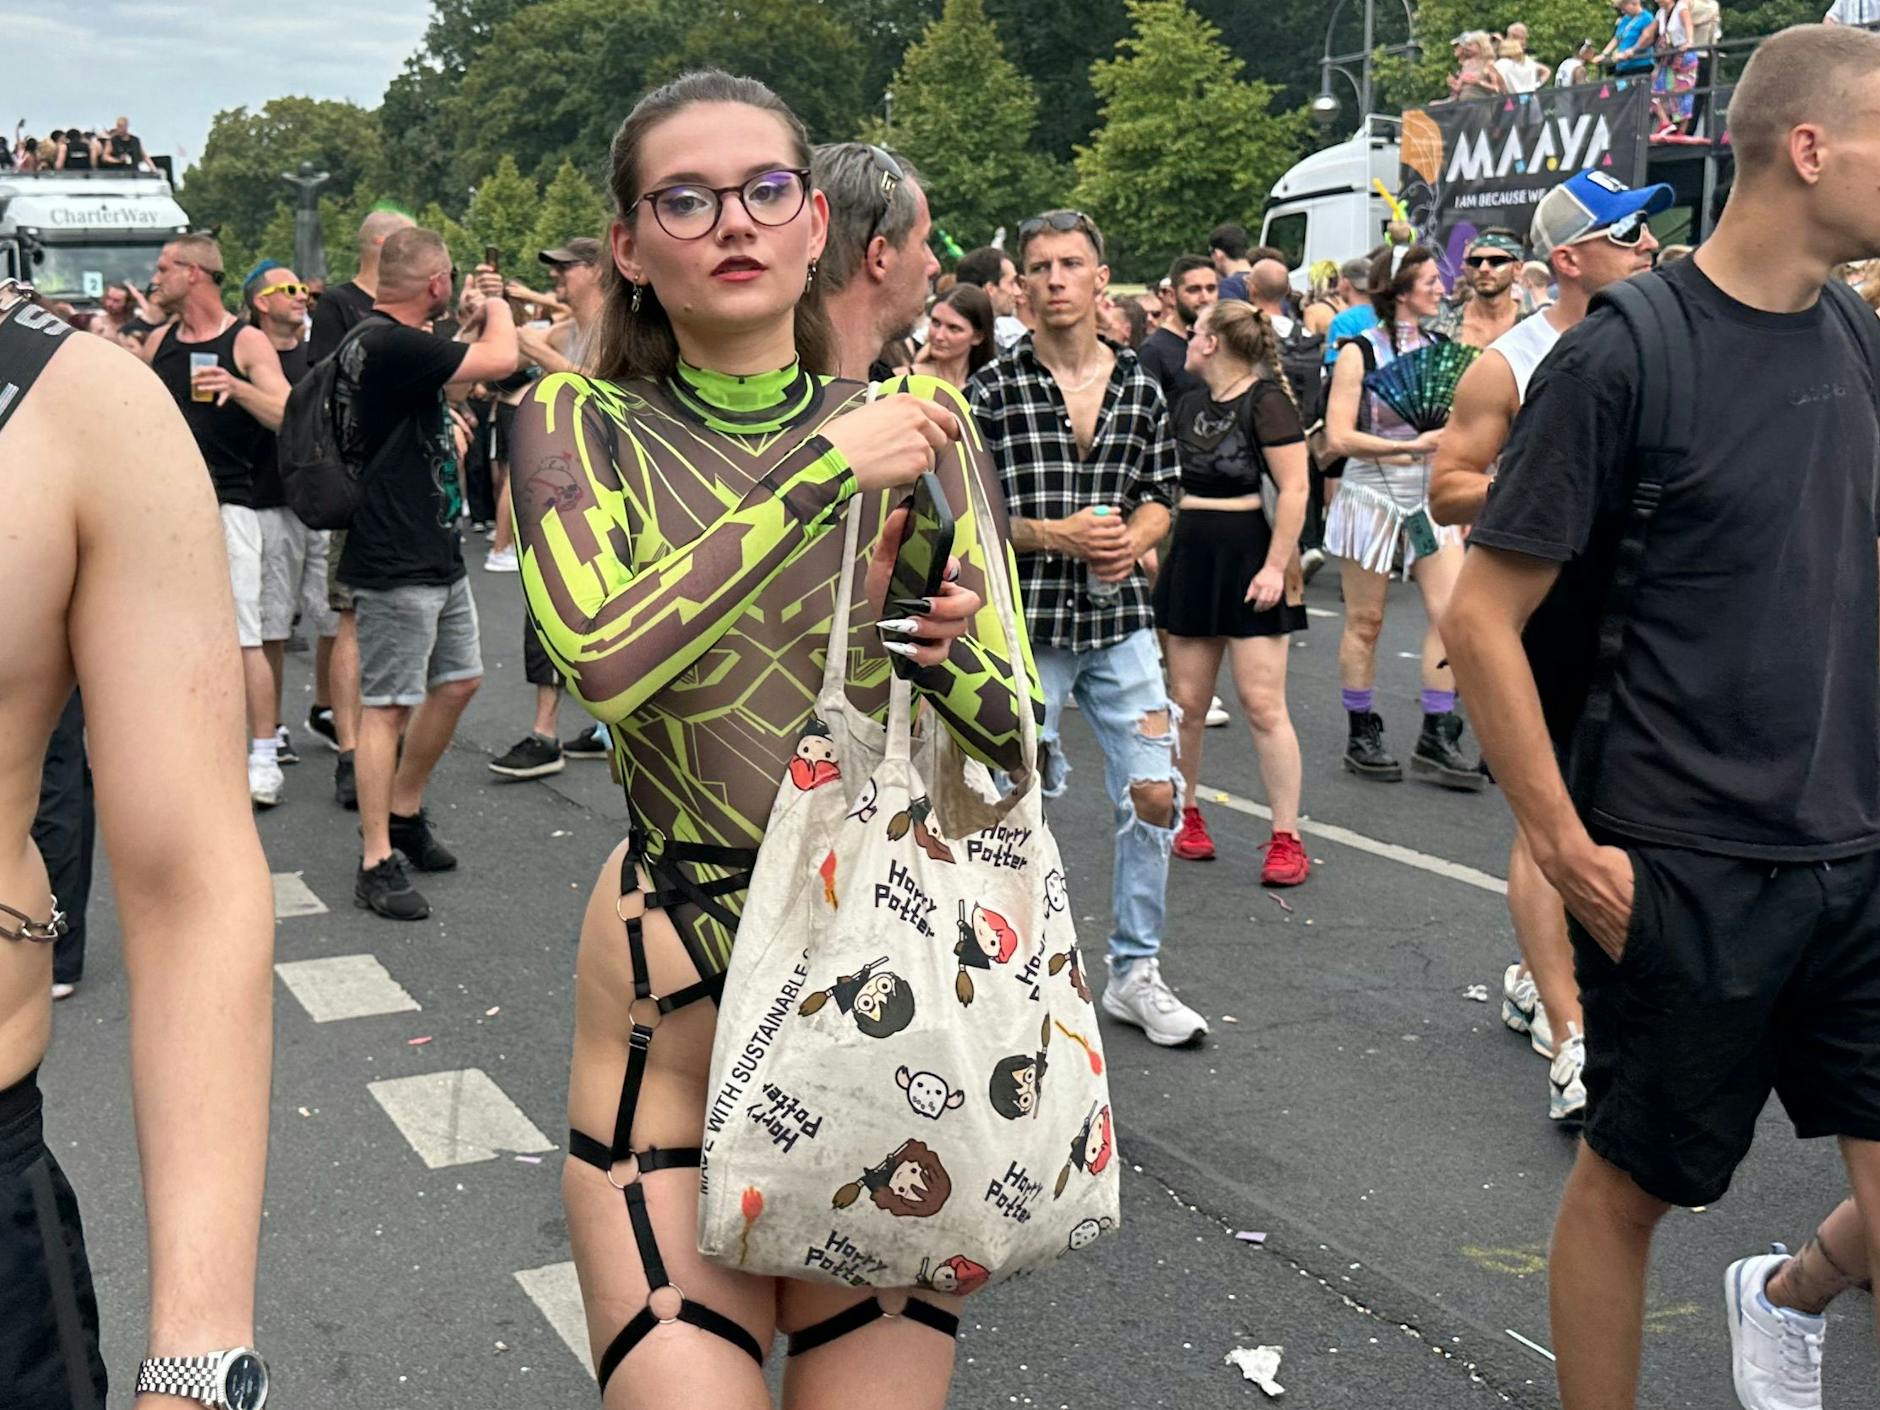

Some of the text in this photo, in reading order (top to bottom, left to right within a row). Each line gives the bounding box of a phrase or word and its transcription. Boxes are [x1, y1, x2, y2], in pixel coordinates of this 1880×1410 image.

[1445, 114, 1613, 183] MAAYA
[51, 207, 159, 225] CharterWay
[1459, 194, 1477, 208] AM
[1478, 190, 1527, 207] BECAUSE
[967, 840, 1028, 870] Potter
[980, 821, 1032, 847] Harry
[888, 859, 937, 914] Harry
[875, 883, 935, 938] Potter
[708, 1083, 743, 1133] WITH
[732, 964, 809, 1083] SUSTAINABLE
[747, 1103, 799, 1154] Harry
[762, 1082, 824, 1139] Potter
[984, 1178, 1032, 1224] Potter
[1003, 1160, 1043, 1202] Harry
[824, 1229, 888, 1273] Harry
